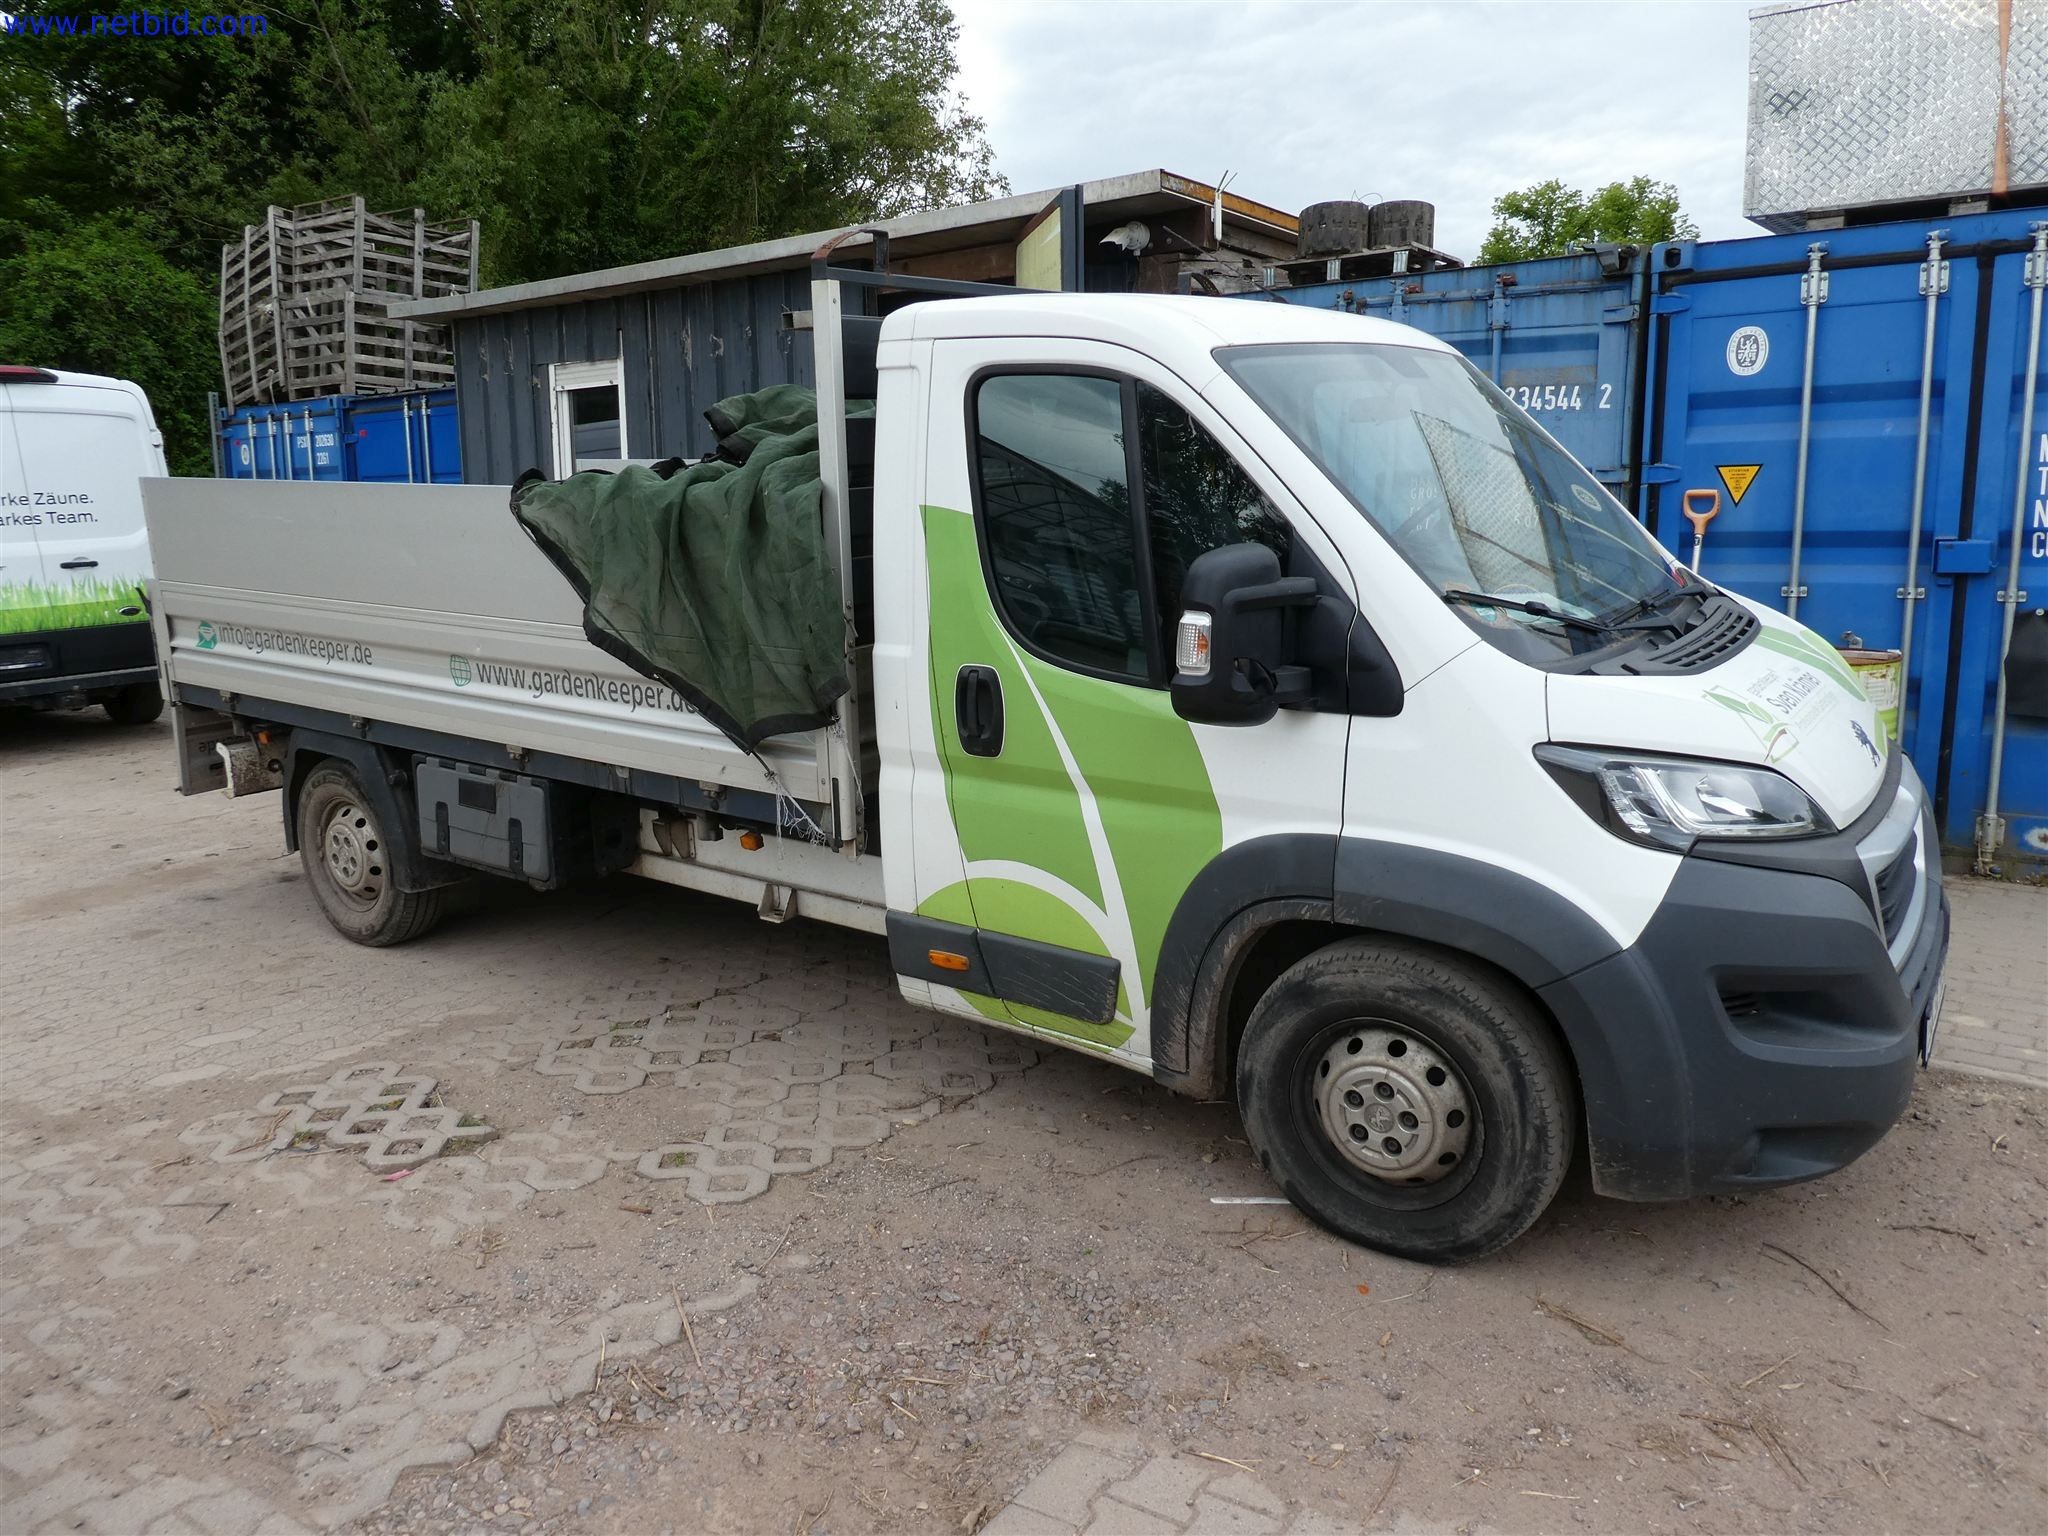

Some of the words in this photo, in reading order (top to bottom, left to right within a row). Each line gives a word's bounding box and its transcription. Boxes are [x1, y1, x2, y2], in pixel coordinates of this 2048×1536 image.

[1598, 383, 1613, 409] 2
[33, 492, 94, 506] Zäune.
[45, 511, 99, 525] Team.
[218, 622, 373, 666] info@gardenkeeper.de
